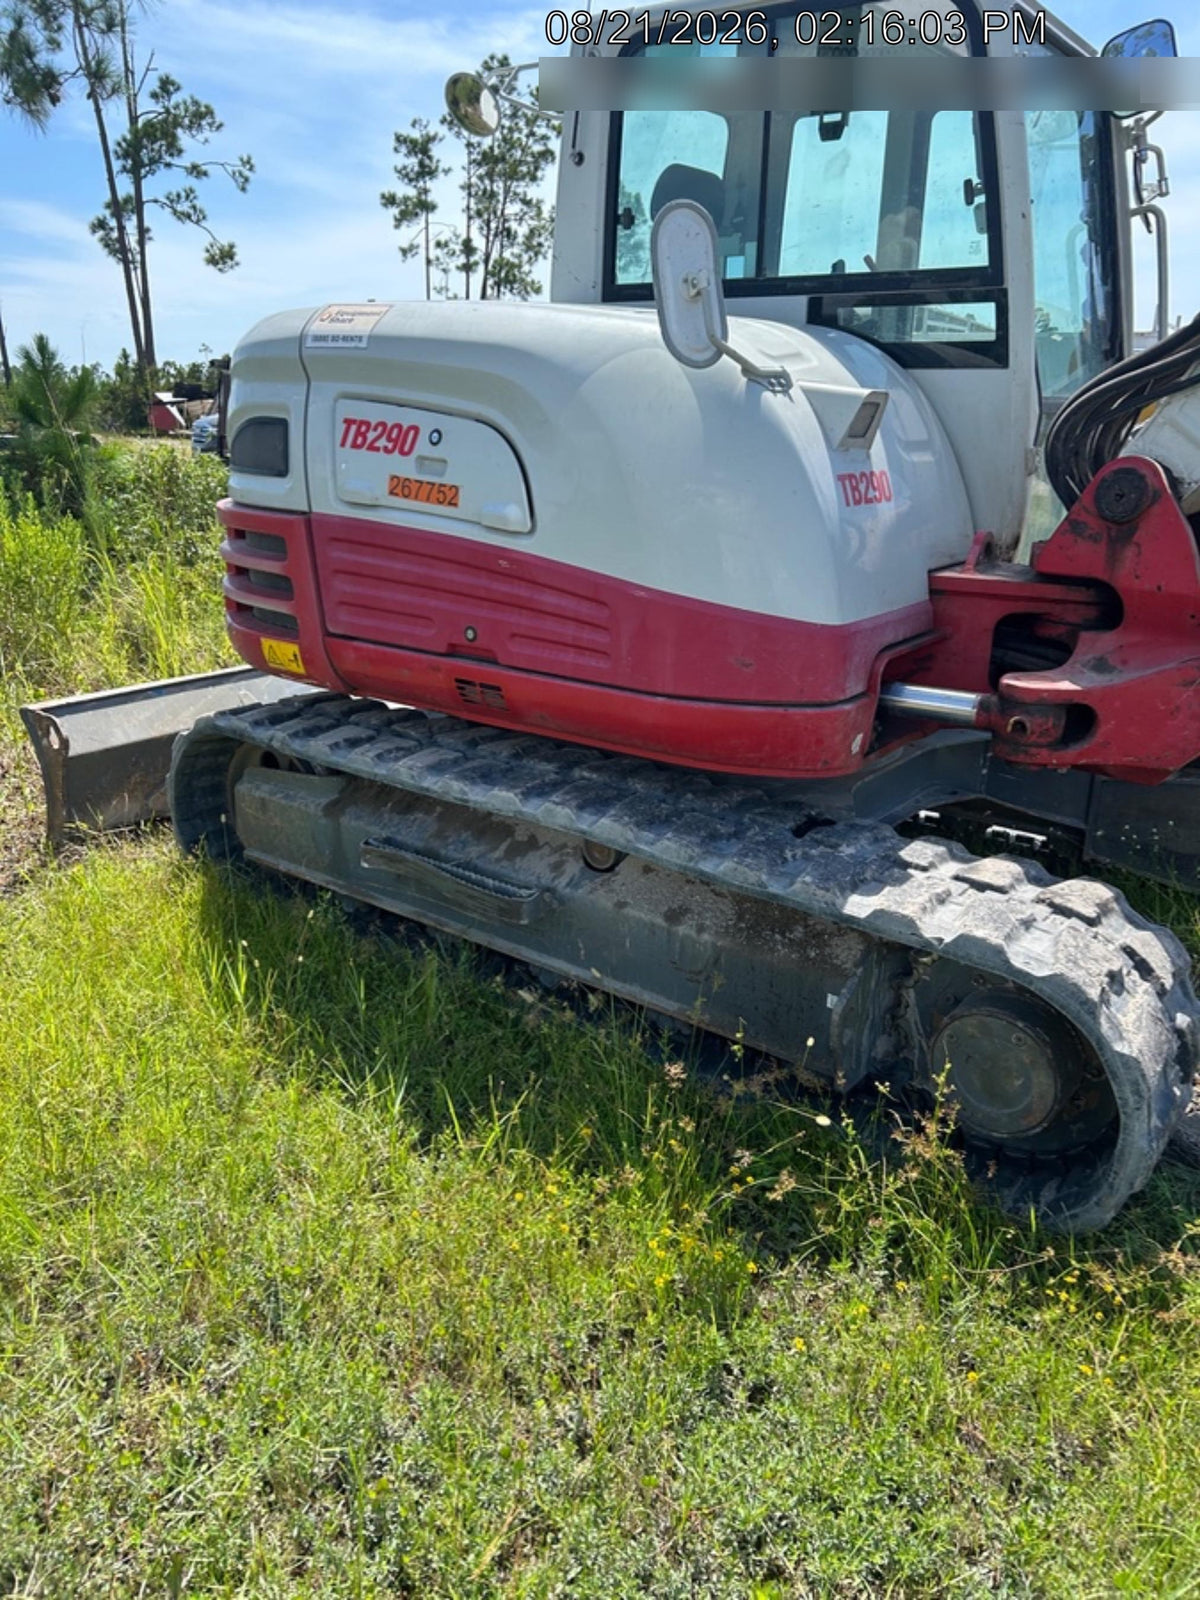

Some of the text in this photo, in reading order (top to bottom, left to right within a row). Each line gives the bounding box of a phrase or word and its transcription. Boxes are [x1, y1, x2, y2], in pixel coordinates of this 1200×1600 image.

[340, 417, 420, 457] TB290
[388, 475, 459, 508] 267752
[836, 470, 892, 507] TB290
